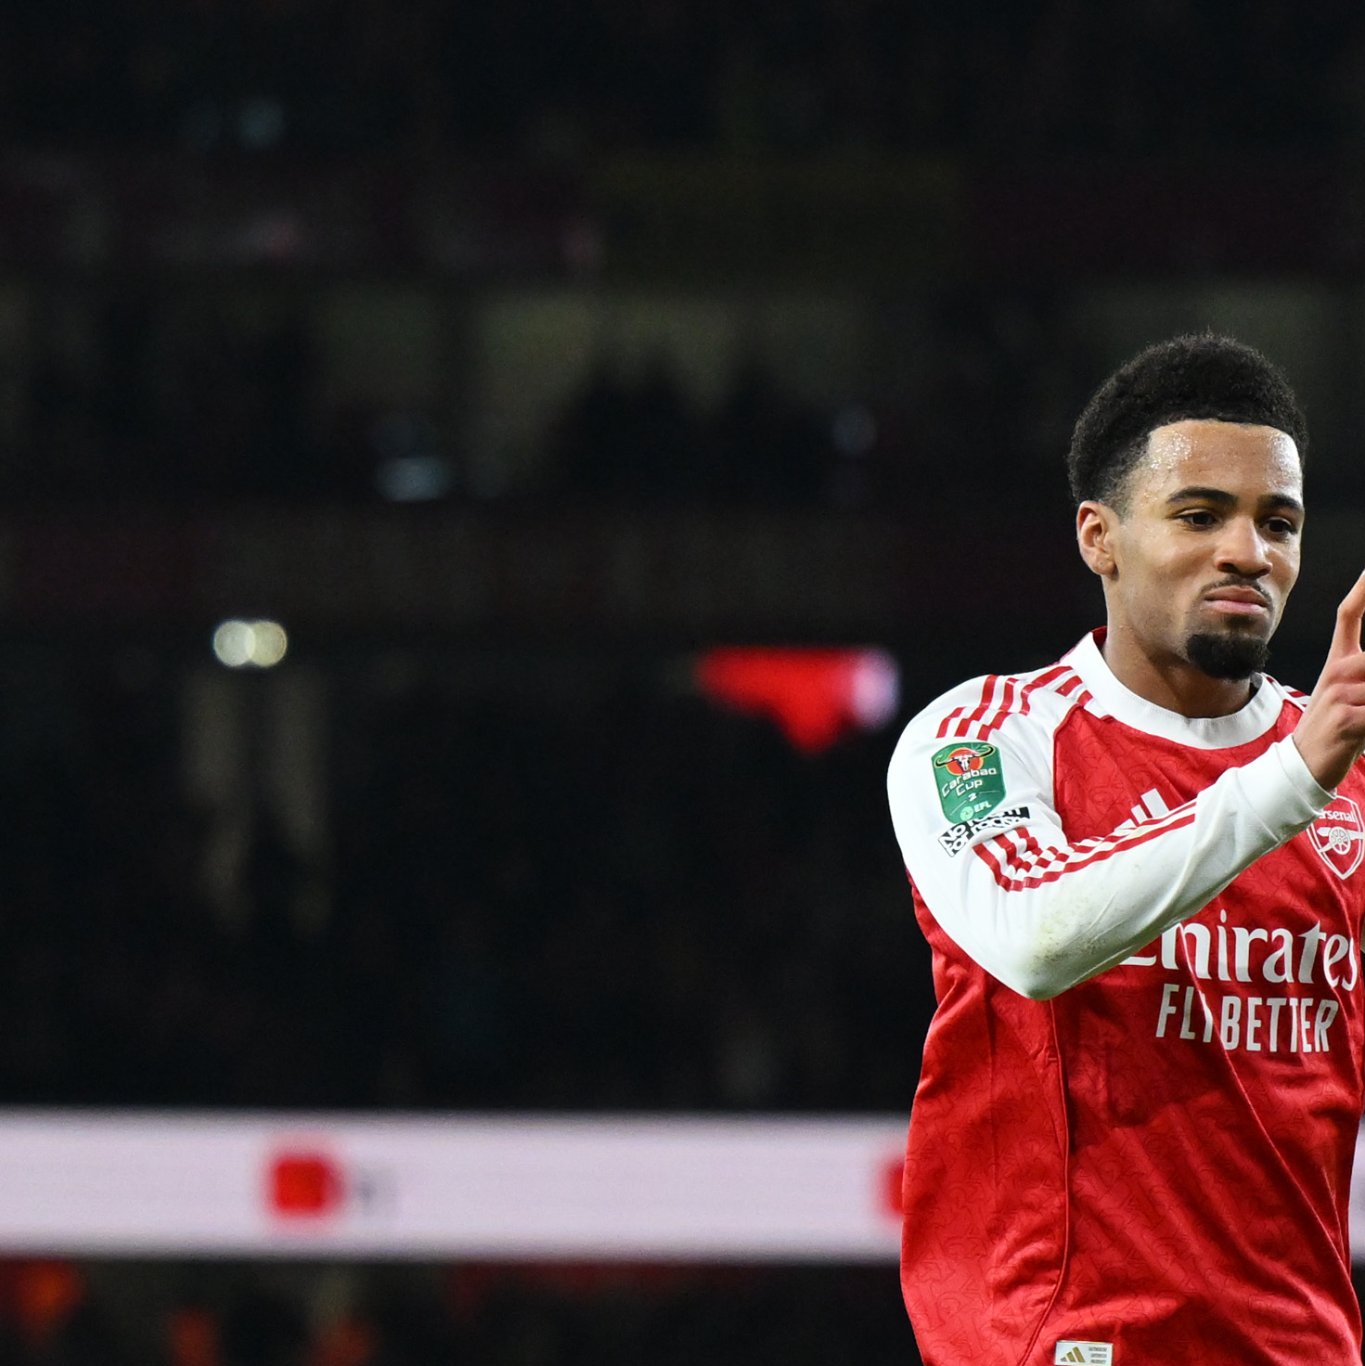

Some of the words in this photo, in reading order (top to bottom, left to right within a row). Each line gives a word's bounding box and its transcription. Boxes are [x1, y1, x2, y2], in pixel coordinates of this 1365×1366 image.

[941, 767, 997, 798] Carabao
[955, 778, 983, 797] Cup
[1319, 810, 1356, 823] rsenal
[1118, 908, 1358, 991] mirates
[1220, 995, 1339, 1053] BETTER
